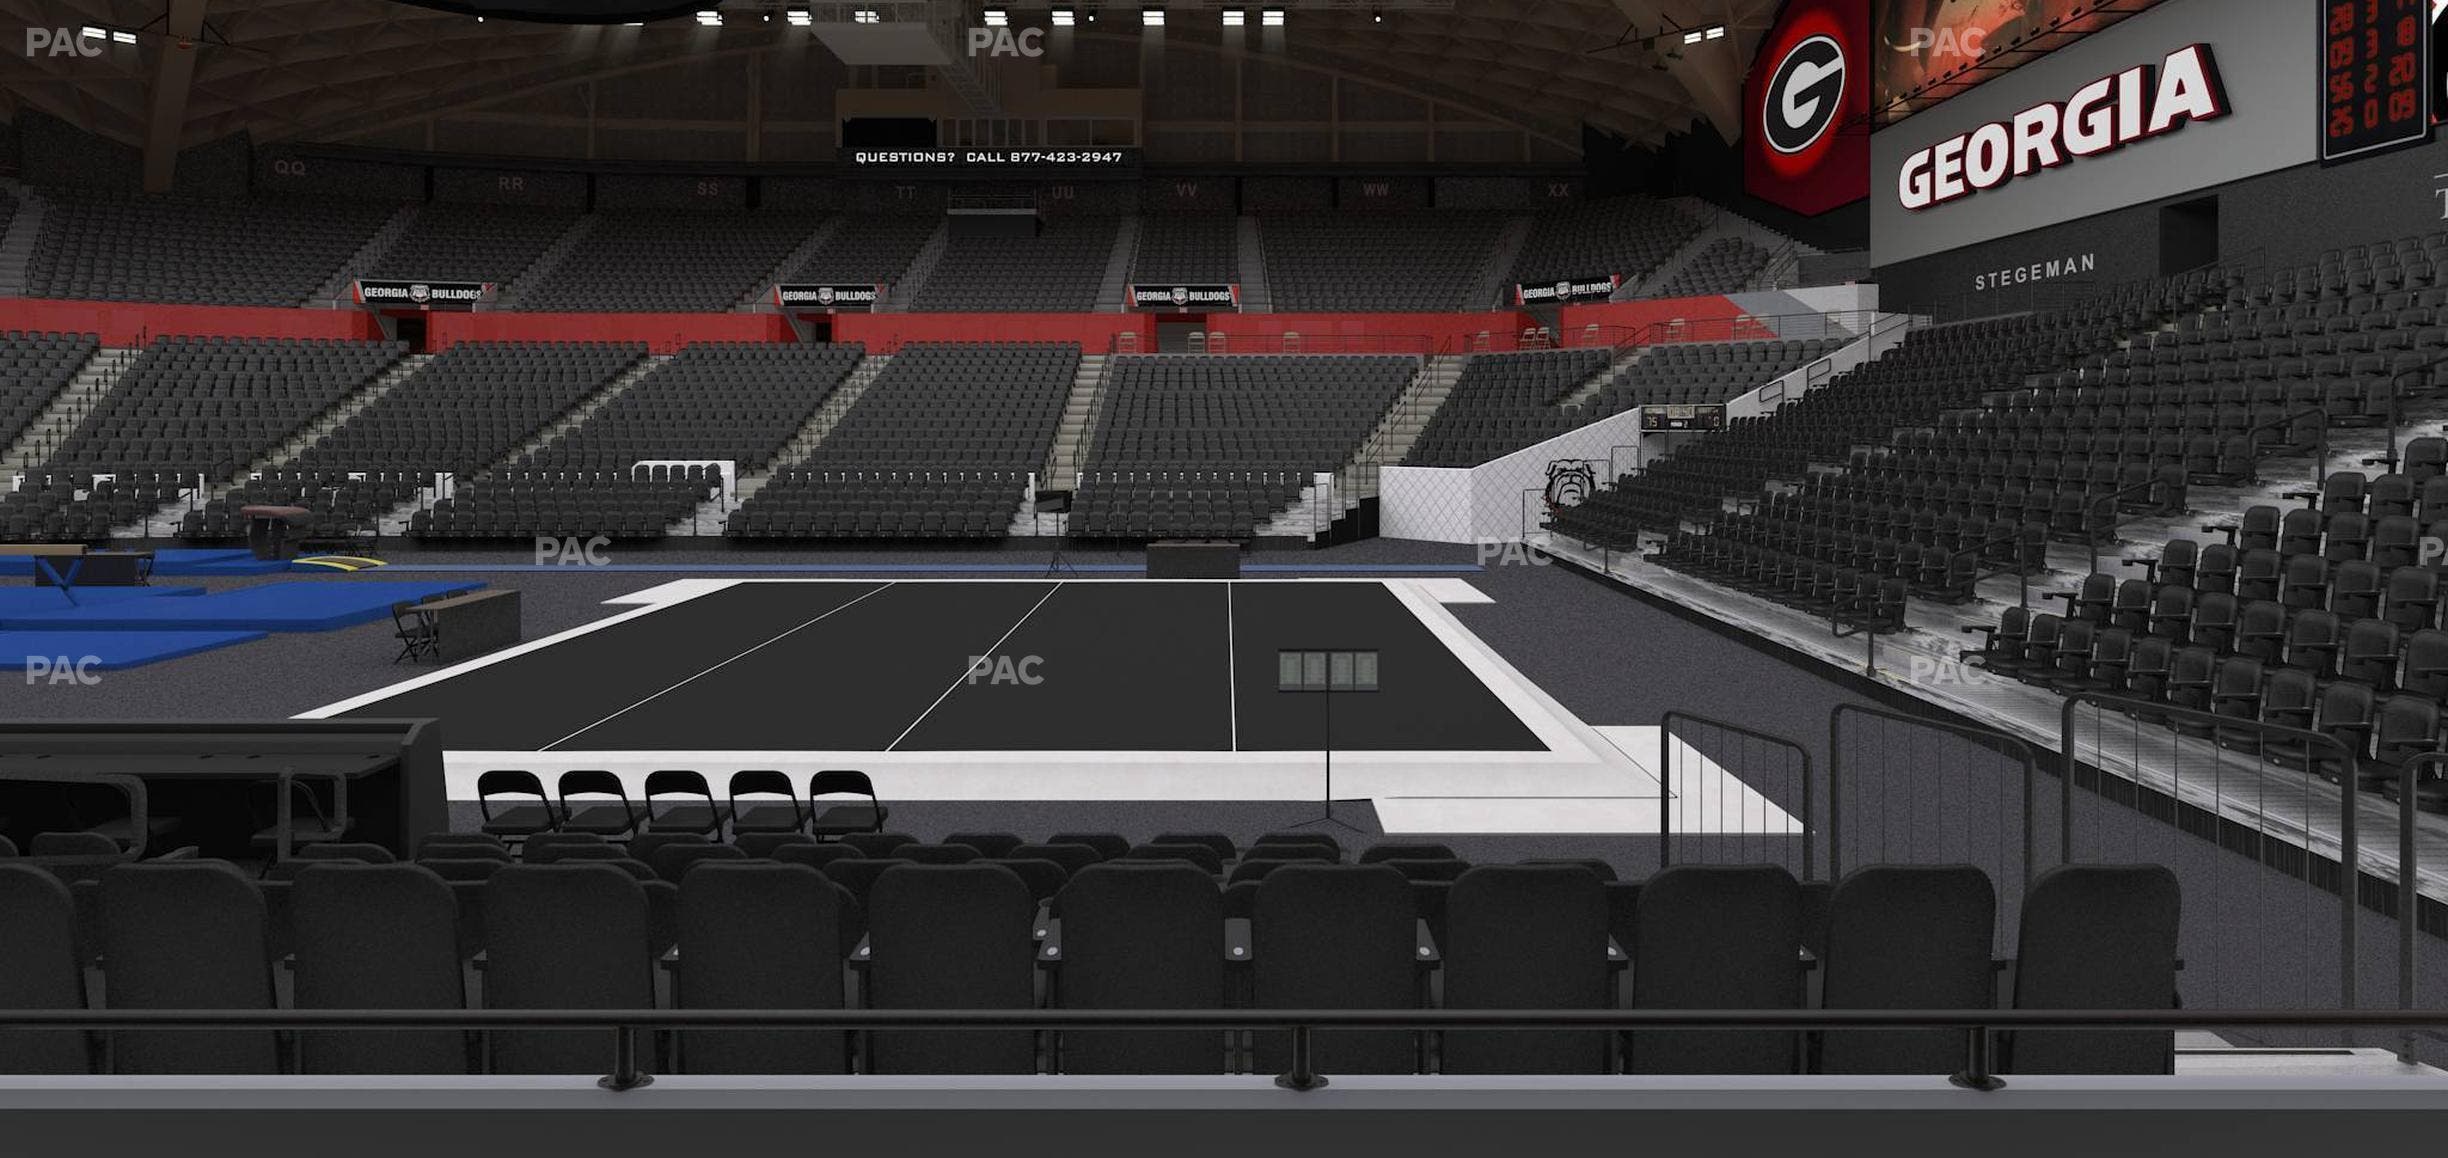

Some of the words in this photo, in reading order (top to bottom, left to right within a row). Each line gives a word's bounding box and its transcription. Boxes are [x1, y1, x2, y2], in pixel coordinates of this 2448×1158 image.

[1763, 36, 1845, 152] G
[1898, 44, 2222, 210] GEORGIA
[855, 152, 955, 164] QUESTIONS?
[966, 152, 1005, 163] CALL
[1010, 152, 1122, 163] 877-423-2947
[274, 160, 305, 176] QQ
[498, 176, 524, 191] RR
[696, 182, 719, 196] SS
[1176, 183, 1198, 198] VV
[1363, 183, 1390, 197] WW
[1548, 183, 1569, 197] XX
[895, 185, 916, 200] TT
[1052, 186, 1074, 200] UU
[1975, 253, 2095, 291] STEGEMAN
[364, 287, 409, 298] GEORGIA
[782, 291, 818, 301] GEORGIA
[835, 291, 876, 301] BULLDOGS
[1136, 291, 1172, 301] GEORGIA
[1189, 291, 1230, 301] BULLDOGS
[1523, 287, 1556, 299] GEORGIA
[1571, 282, 1612, 295] BULLDOGS
